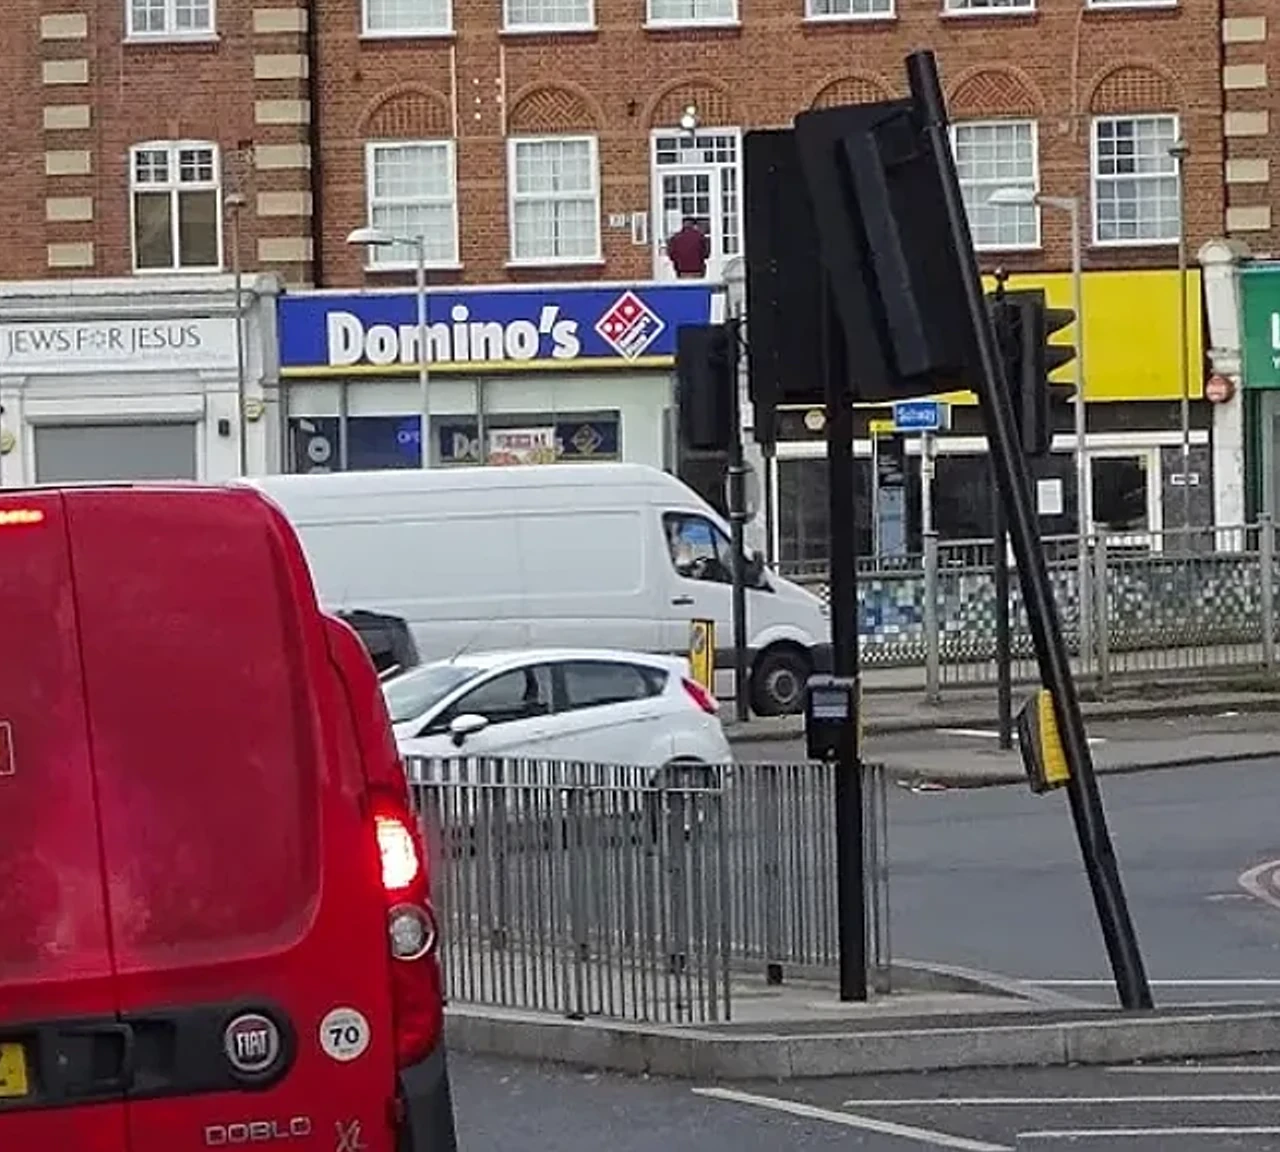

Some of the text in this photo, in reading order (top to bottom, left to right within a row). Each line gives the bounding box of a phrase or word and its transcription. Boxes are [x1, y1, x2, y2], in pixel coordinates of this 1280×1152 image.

[7, 325, 202, 359] JEWS FOR JESUS
[325, 303, 582, 367] Domino's
[235, 1029, 268, 1058] FIAT
[329, 1025, 361, 1047] 70
[204, 1116, 312, 1146] DOBLO
